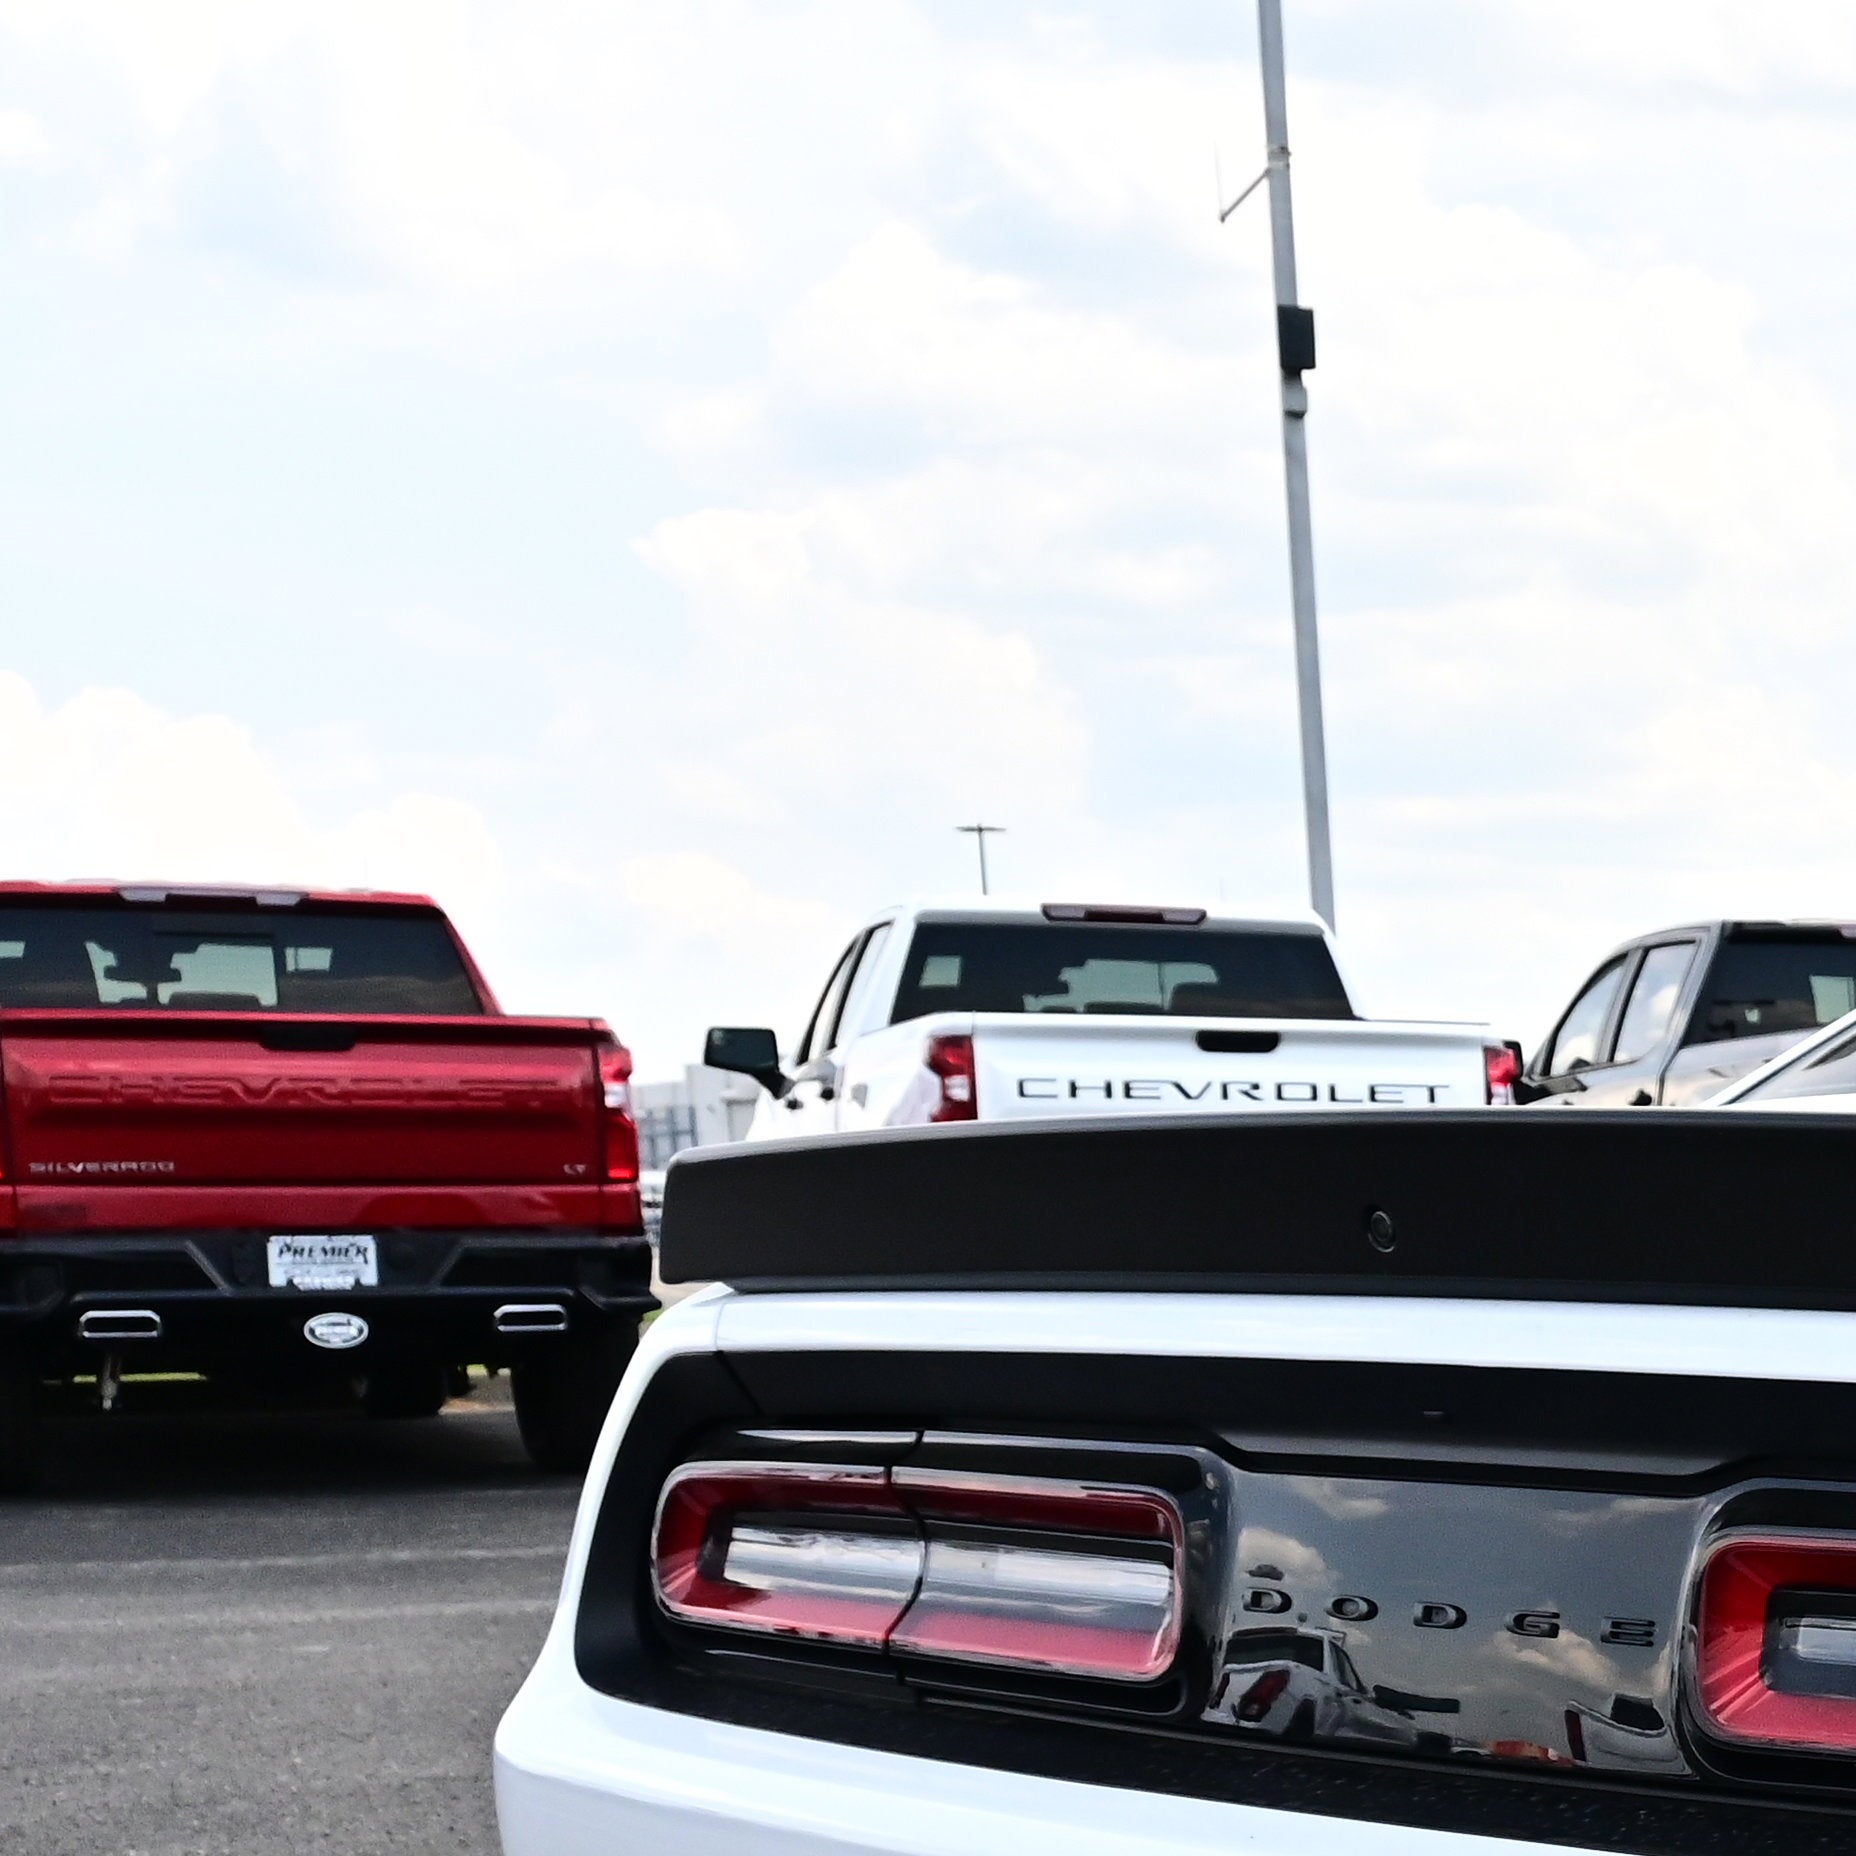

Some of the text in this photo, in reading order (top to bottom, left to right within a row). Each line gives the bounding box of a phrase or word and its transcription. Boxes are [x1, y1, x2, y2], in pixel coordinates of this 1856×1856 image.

[46, 1075, 562, 1108] CHEVROLET
[1018, 1077, 1450, 1104] CHEVROLET
[28, 1161, 176, 1174] SILVERADO
[278, 1242, 368, 1265] PREMIER
[1242, 1587, 1656, 1647] DODGE
